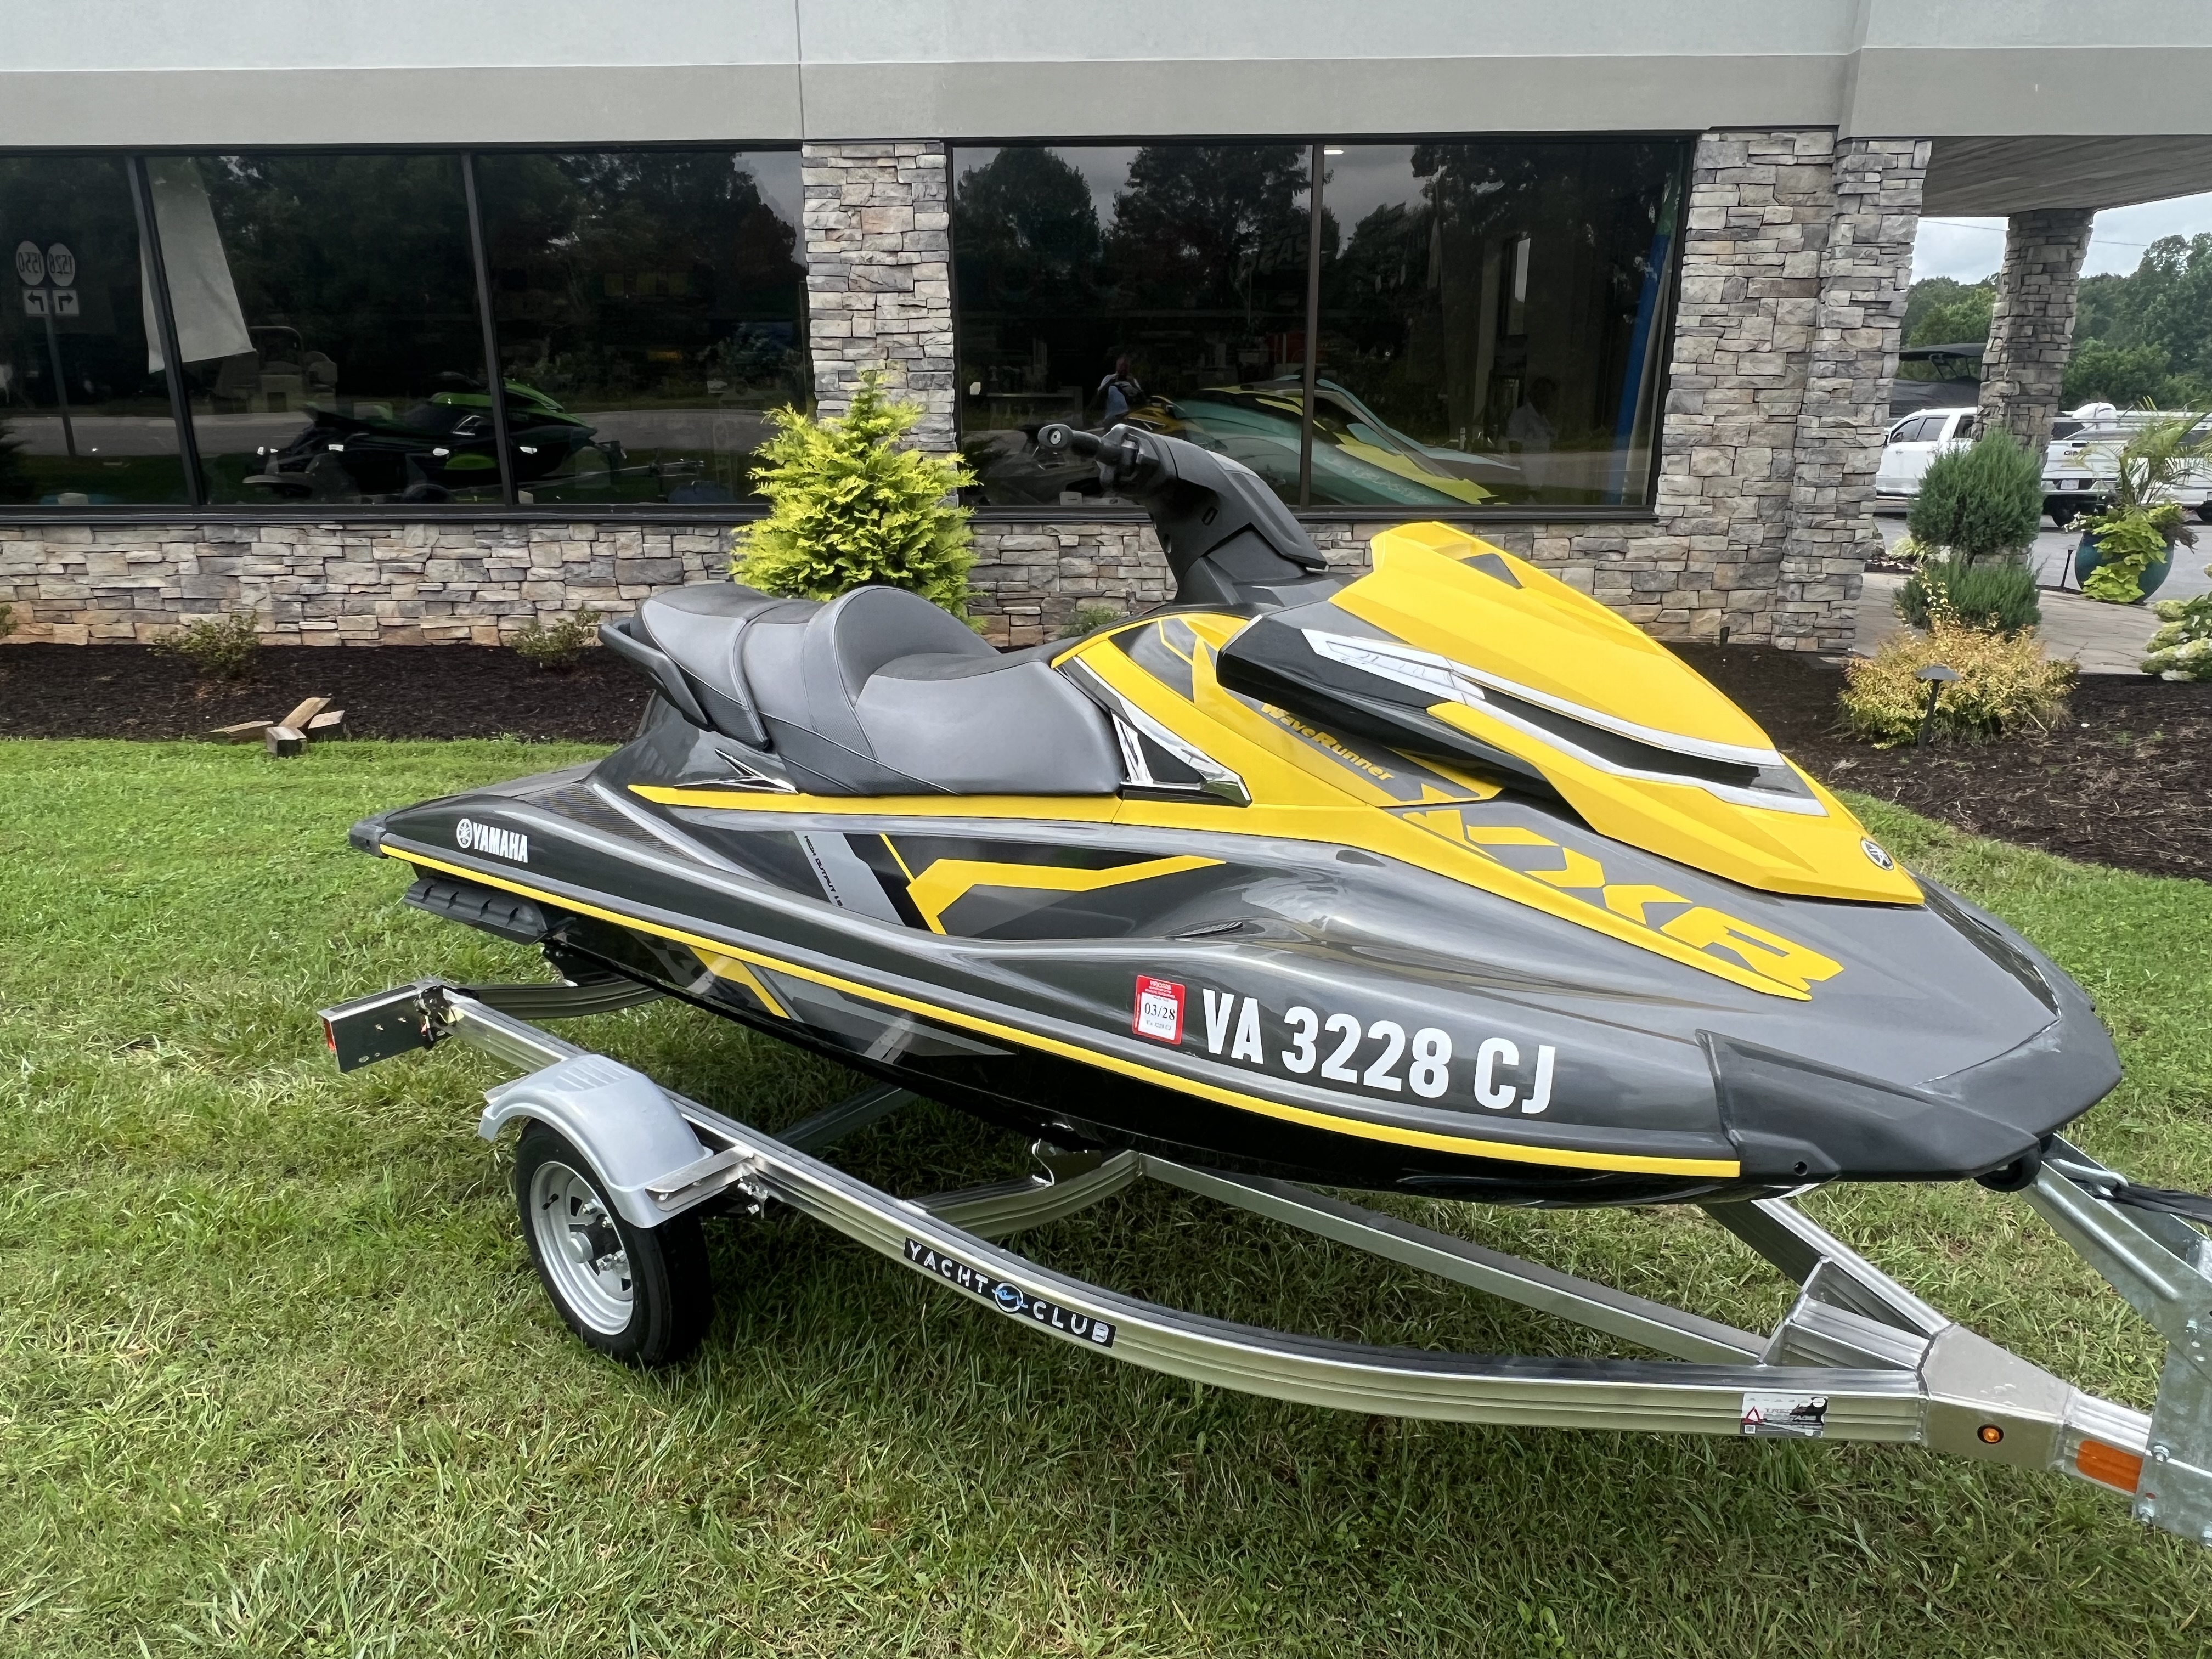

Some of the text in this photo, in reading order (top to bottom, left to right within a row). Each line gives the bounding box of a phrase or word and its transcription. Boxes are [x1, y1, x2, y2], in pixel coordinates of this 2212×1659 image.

[1261, 703, 1395, 781] WaveRunner
[473, 822, 528, 864] YAMAHA
[815, 857, 837, 893] OUTPUT
[1144, 1002, 1176, 1021] 03/28
[1203, 989, 1264, 1064] VA
[1281, 1006, 1452, 1098] 3228
[1474, 1037, 1556, 1114] CJ
[910, 1240, 1109, 1344] YACHT CLUB
